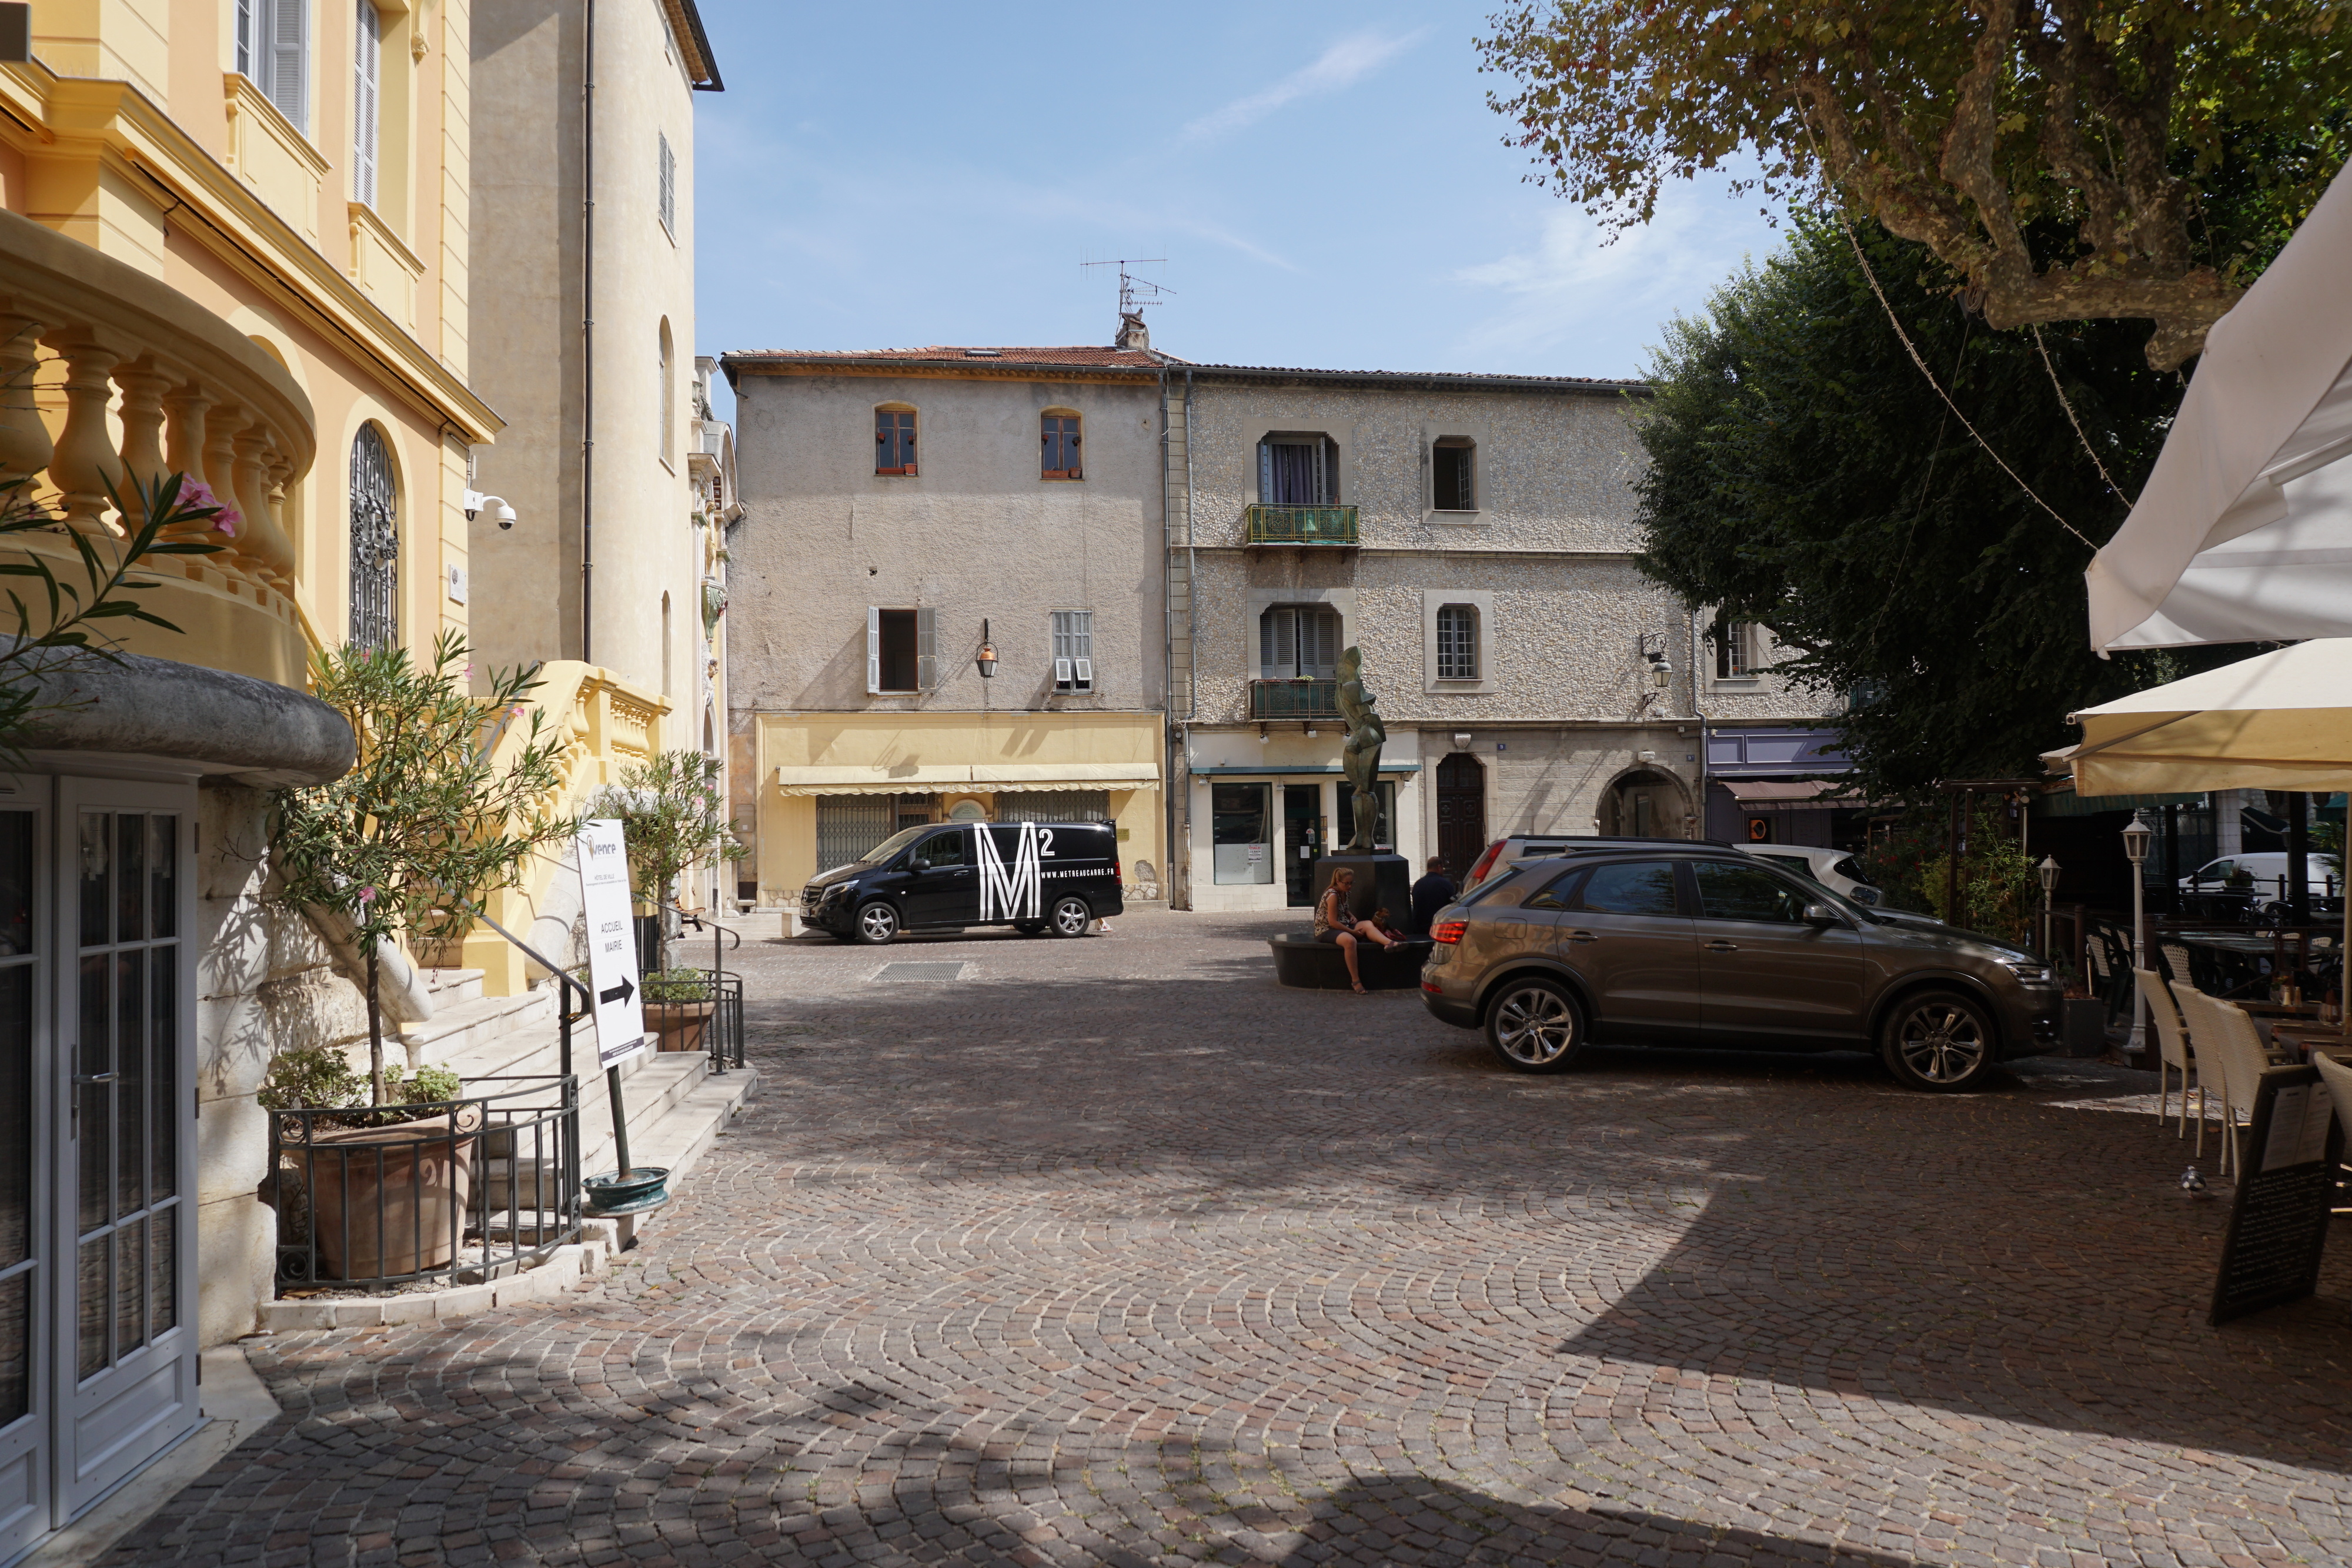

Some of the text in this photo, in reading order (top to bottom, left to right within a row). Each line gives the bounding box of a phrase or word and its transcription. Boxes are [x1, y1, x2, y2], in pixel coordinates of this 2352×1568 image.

[1041, 868, 1114, 879] WWW.METREAUCARRE.FR
[601, 920, 623, 934] ACCUEIL
[604, 940, 623, 953] MAIRIE
